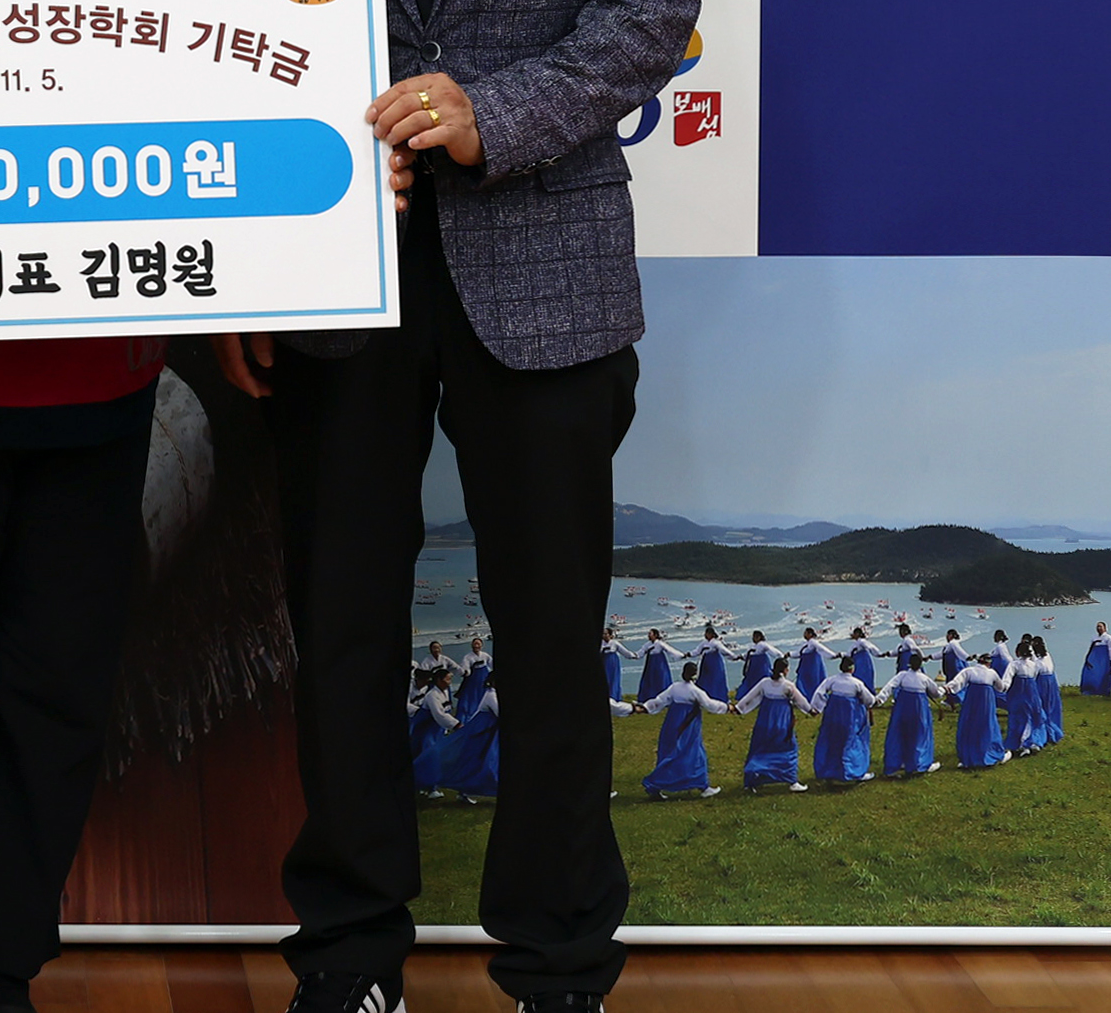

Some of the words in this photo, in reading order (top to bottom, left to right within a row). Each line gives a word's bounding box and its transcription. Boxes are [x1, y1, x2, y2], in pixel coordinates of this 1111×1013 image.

[1, 69, 31, 92] 11.
[41, 69, 64, 91] 5.
[187, 21, 311, 87] 기탁금
[674, 92, 721, 140] 보배섬
[79, 239, 218, 299] 김명월
